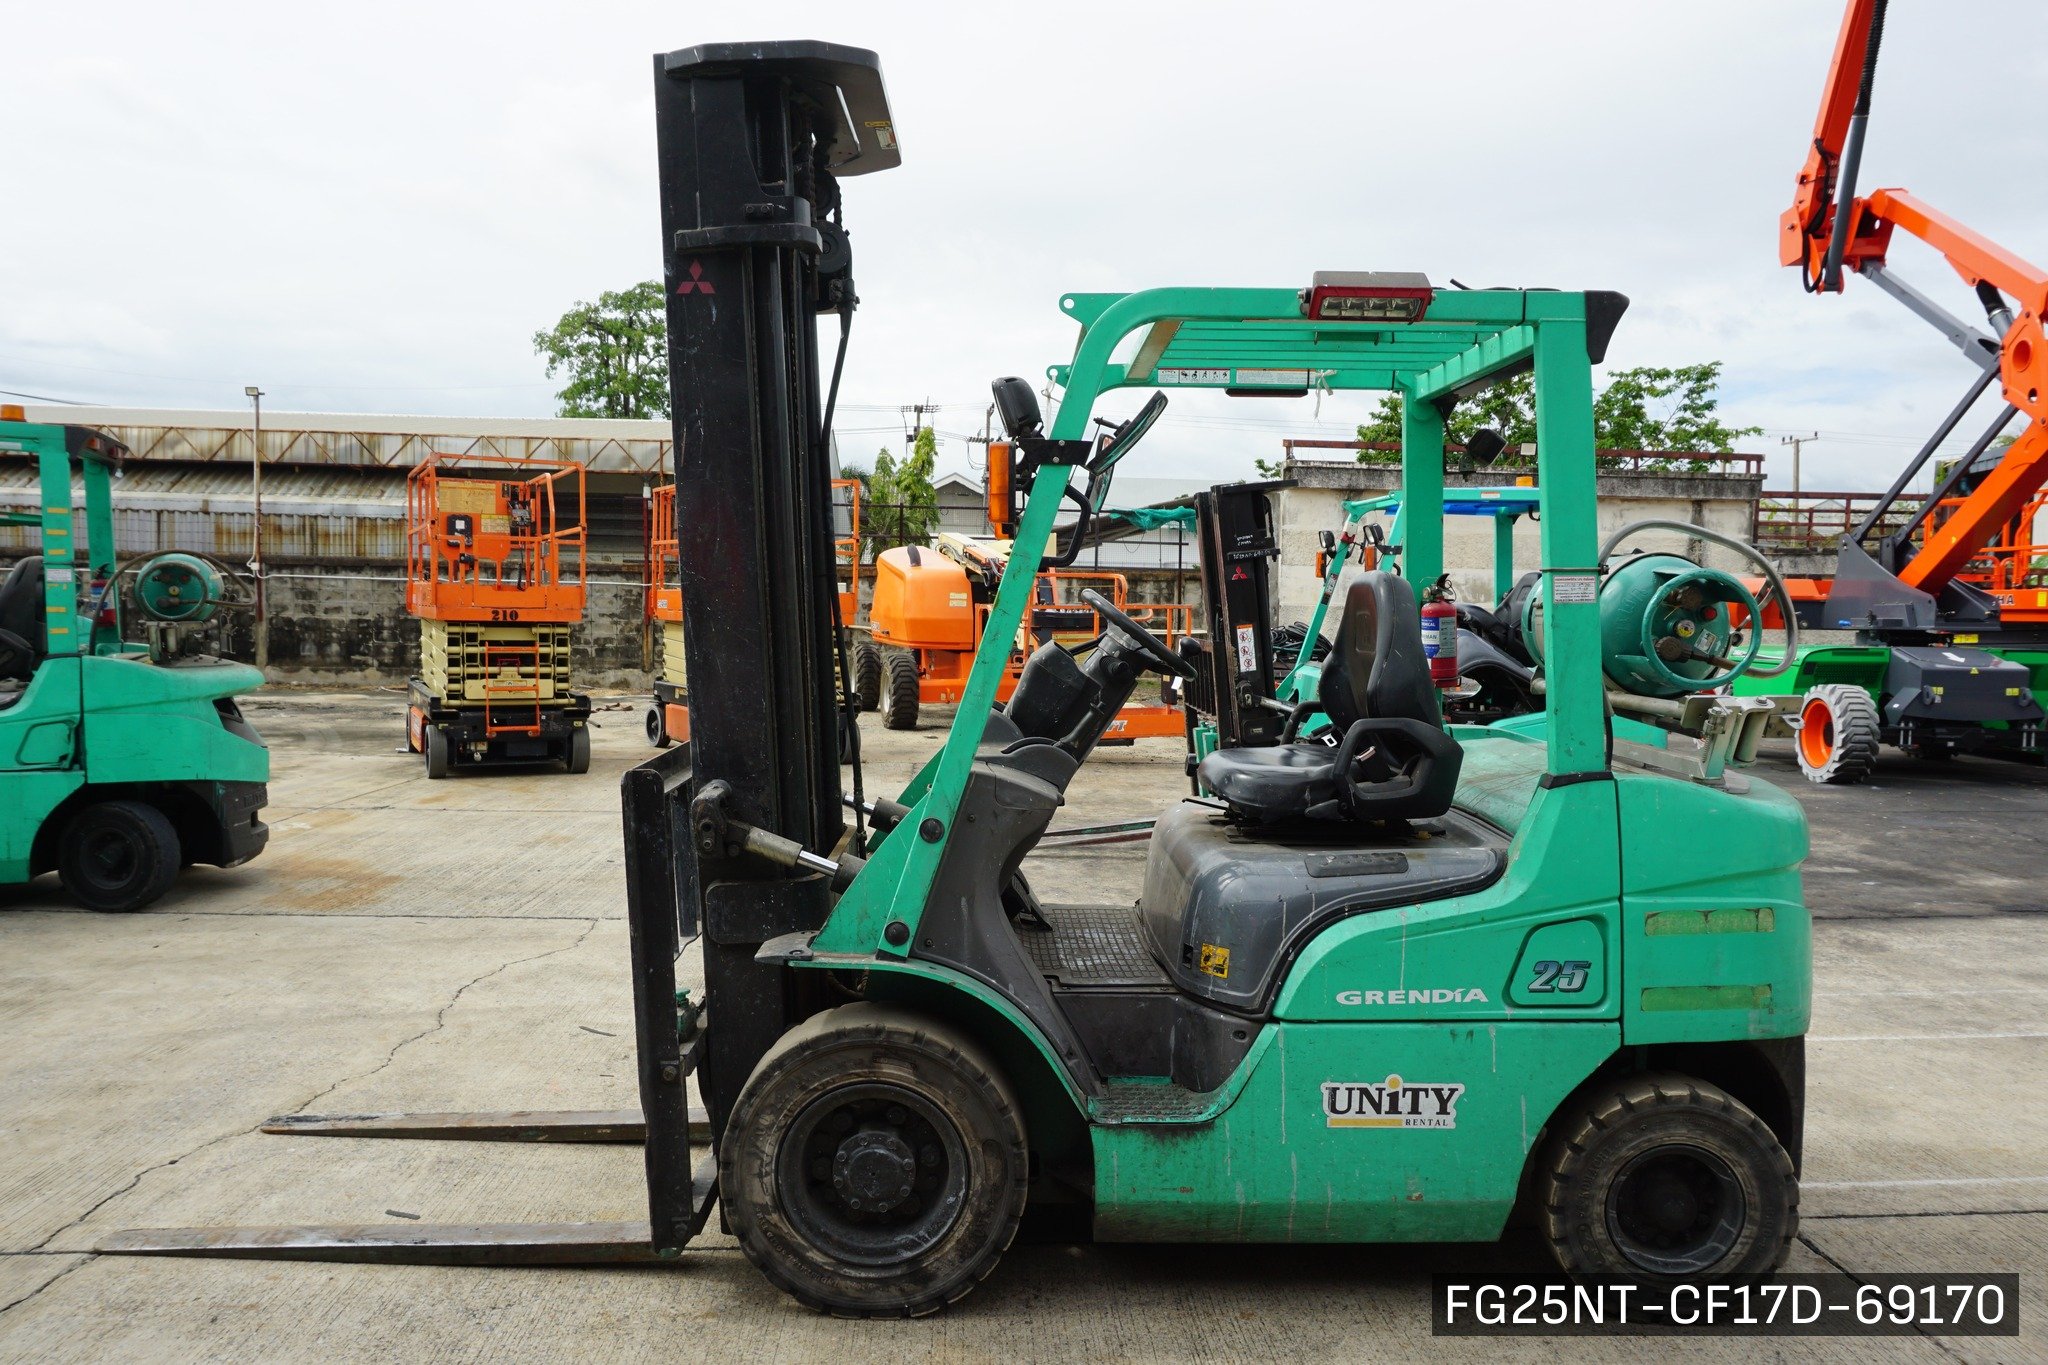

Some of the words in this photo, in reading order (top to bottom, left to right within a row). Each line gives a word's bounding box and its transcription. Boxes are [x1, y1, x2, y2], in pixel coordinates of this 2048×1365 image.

[491, 609, 519, 621] 210
[1527, 960, 1592, 993] 25
[1405, 1118, 1448, 1127] RENTAL
